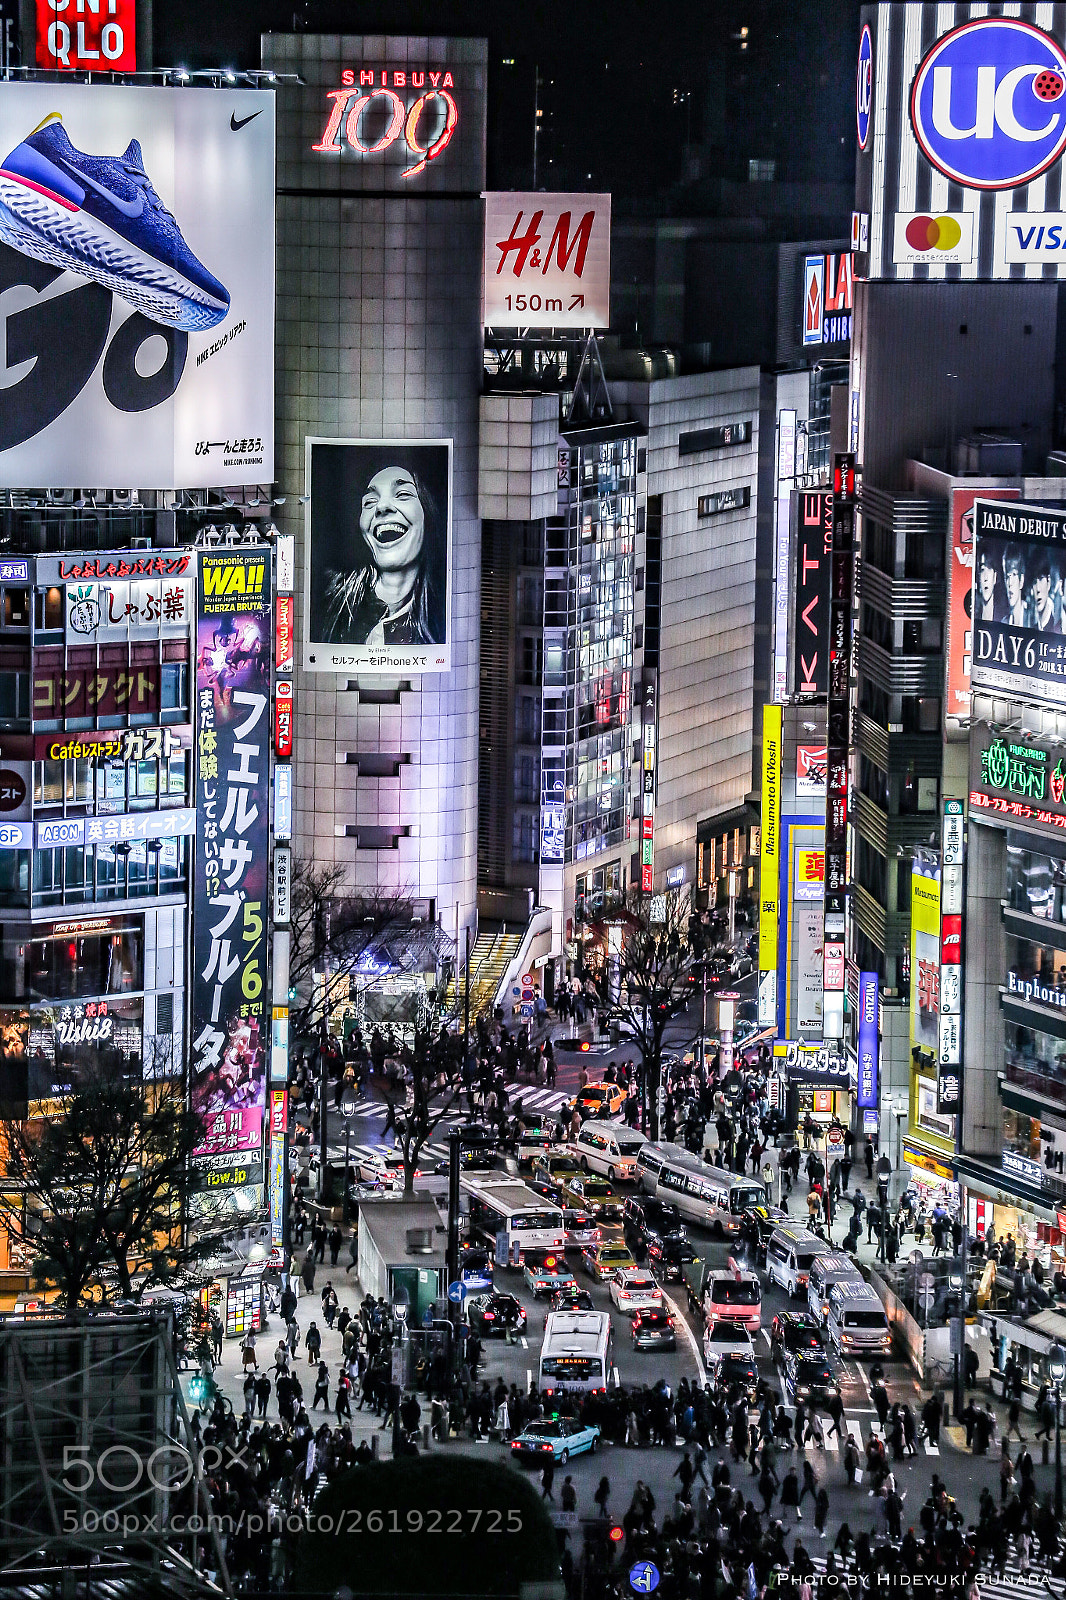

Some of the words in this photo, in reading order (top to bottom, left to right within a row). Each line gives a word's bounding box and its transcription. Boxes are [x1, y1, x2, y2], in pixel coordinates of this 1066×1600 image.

[47, 20, 124, 65] QLO
[341, 69, 454, 88] SHIBUYA
[312, 88, 458, 177] 109
[496, 210, 595, 278] H&M
[906, 253, 959, 261] mastercard
[981, 511, 1017, 534] JAPAN
[1018, 517, 1059, 539] DEBUT
[0, 565, 27, 578] 寿司
[60, 555, 192, 579] しゃぶしゃぶバイキング
[203, 555, 243, 567] Panasonic
[203, 564, 265, 596] WA!!
[801, 494, 820, 691] KATE
[108, 586, 184, 623] しゃぶ葉
[204, 603, 236, 613] FUERZA
[236, 601, 262, 611] BRUTA
[977, 628, 1036, 668] DAY6
[34, 671, 155, 707] コンタクト
[279, 712, 291, 749] ガスト
[766, 739, 777, 785] KiYoshi
[43, 824, 78, 842] AEON
[765, 789, 777, 857] Matsumoto
[192, 690, 268, 1074] フェルサブルータ
[277, 855, 288, 918] 渋谷駅前ビル
[762, 901, 776, 913] 薬
[86, 1001, 108, 1018] 焼肉
[240, 1001, 263, 1018] まで!
[865, 980, 876, 1023] MIZUHO
[786, 1041, 850, 1076] グルメタウン
[862, 1052, 873, 1098] みずほ銀行
